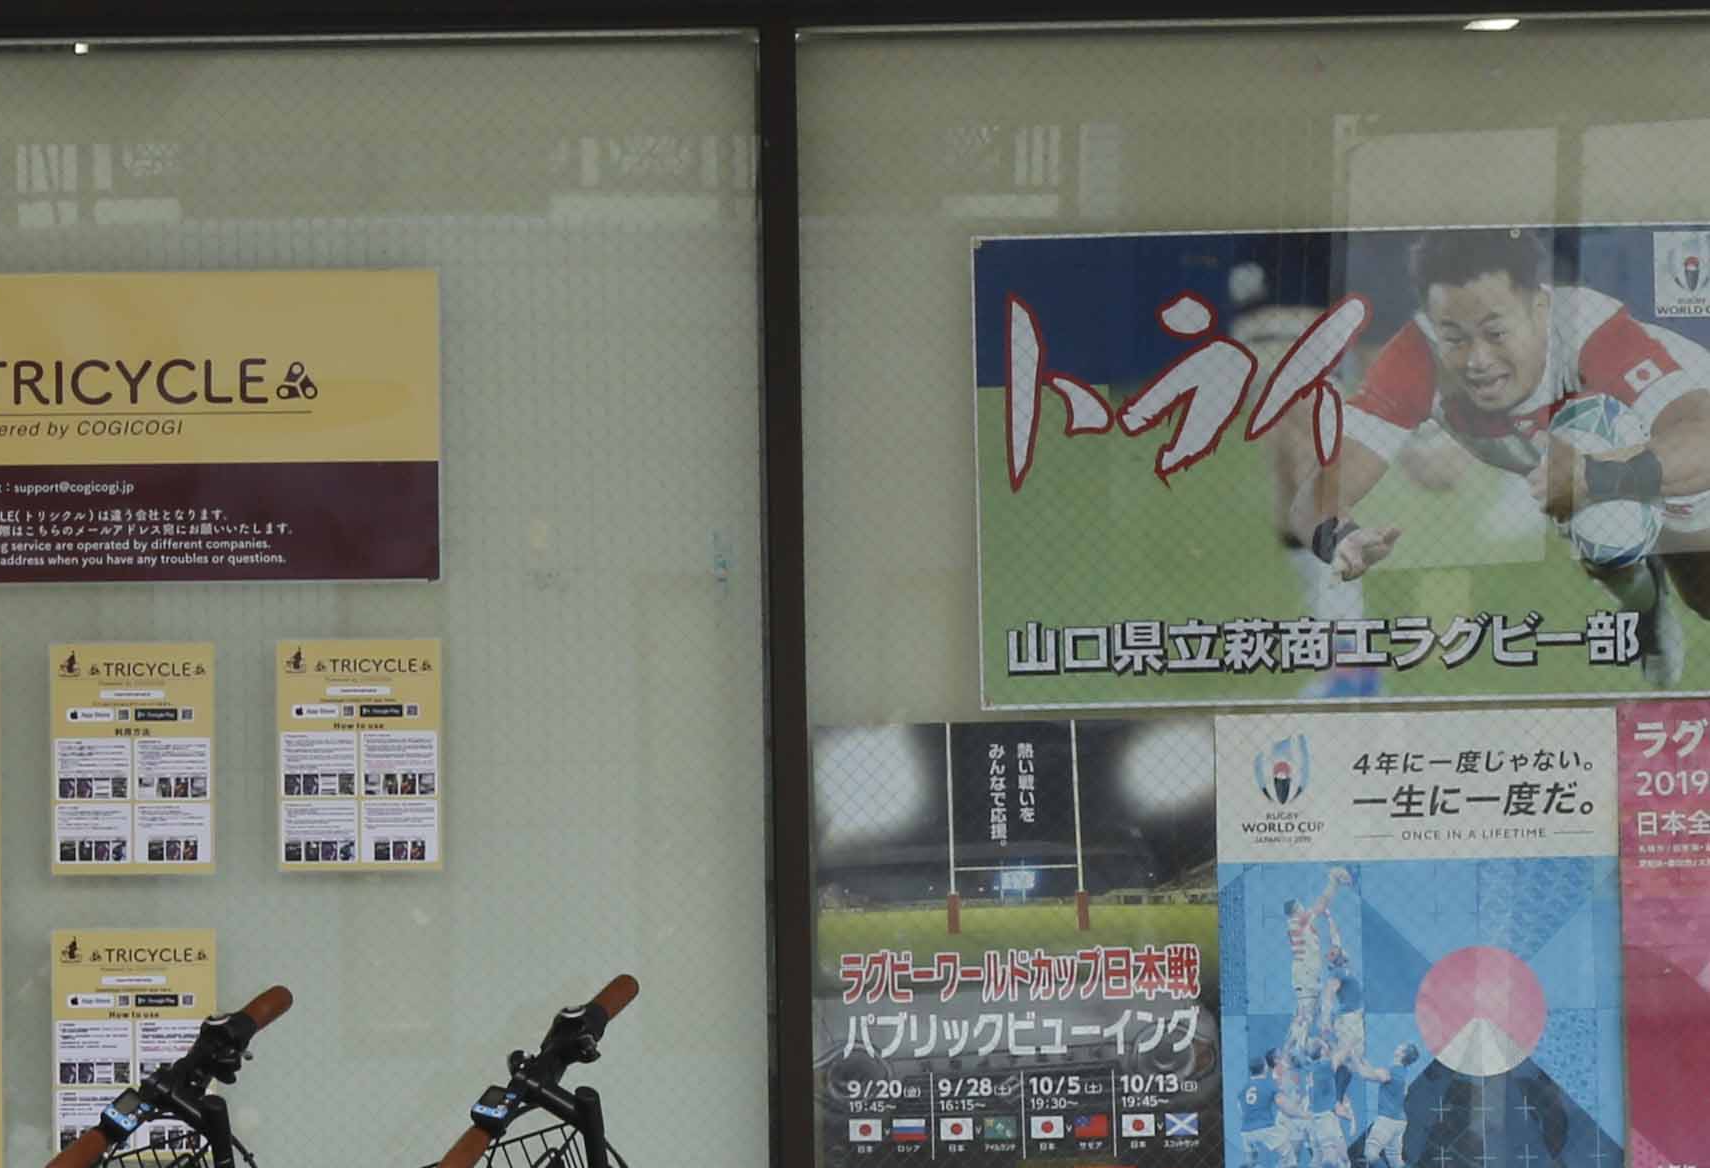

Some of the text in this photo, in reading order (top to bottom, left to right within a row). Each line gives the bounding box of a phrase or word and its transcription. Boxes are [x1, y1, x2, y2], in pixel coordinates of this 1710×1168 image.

[48, 421, 69, 439] by
[77, 419, 183, 437] COGICOGI
[11, 540, 51, 551] service
[55, 541, 73, 551] are
[77, 539, 130, 552] operated
[133, 539, 148, 552] by
[151, 538, 202, 550] different
[206, 538, 271, 551] companies.
[0, 555, 44, 566] address
[48, 554, 78, 565] when
[82, 556, 102, 567] you
[106, 554, 133, 565] have
[137, 556, 157, 567] any
[161, 553, 208, 564] troubles
[212, 555, 225, 564] or
[227, 552, 286, 566] questions.
[1006, 610, 1642, 677] 山口県立萩商工ラグビー部
[103, 662, 192, 677] TRICYCLE
[330, 658, 418, 673] TRICYCLE
[1353, 749, 1595, 776] 4年に一度じゃない。
[1017, 742, 1035, 822] 熱い戦いを
[1636, 770, 1709, 796] 2019
[989, 743, 1008, 847] みんなで応援。
[1353, 781, 1595, 819] 一生に一度だ。
[1242, 822, 1324, 832] WORLD CUP
[1401, 827, 1547, 842] ONCE IN A LIFETIME
[105, 948, 193, 962] TRICYCLE
[839, 943, 1201, 1004] ラグビーワールドカップ日本戦
[843, 1005, 1200, 1058] パブリックビューイング
[897, 1144, 921, 1152] ロシア
[1079, 1141, 1102, 1149] サモア
